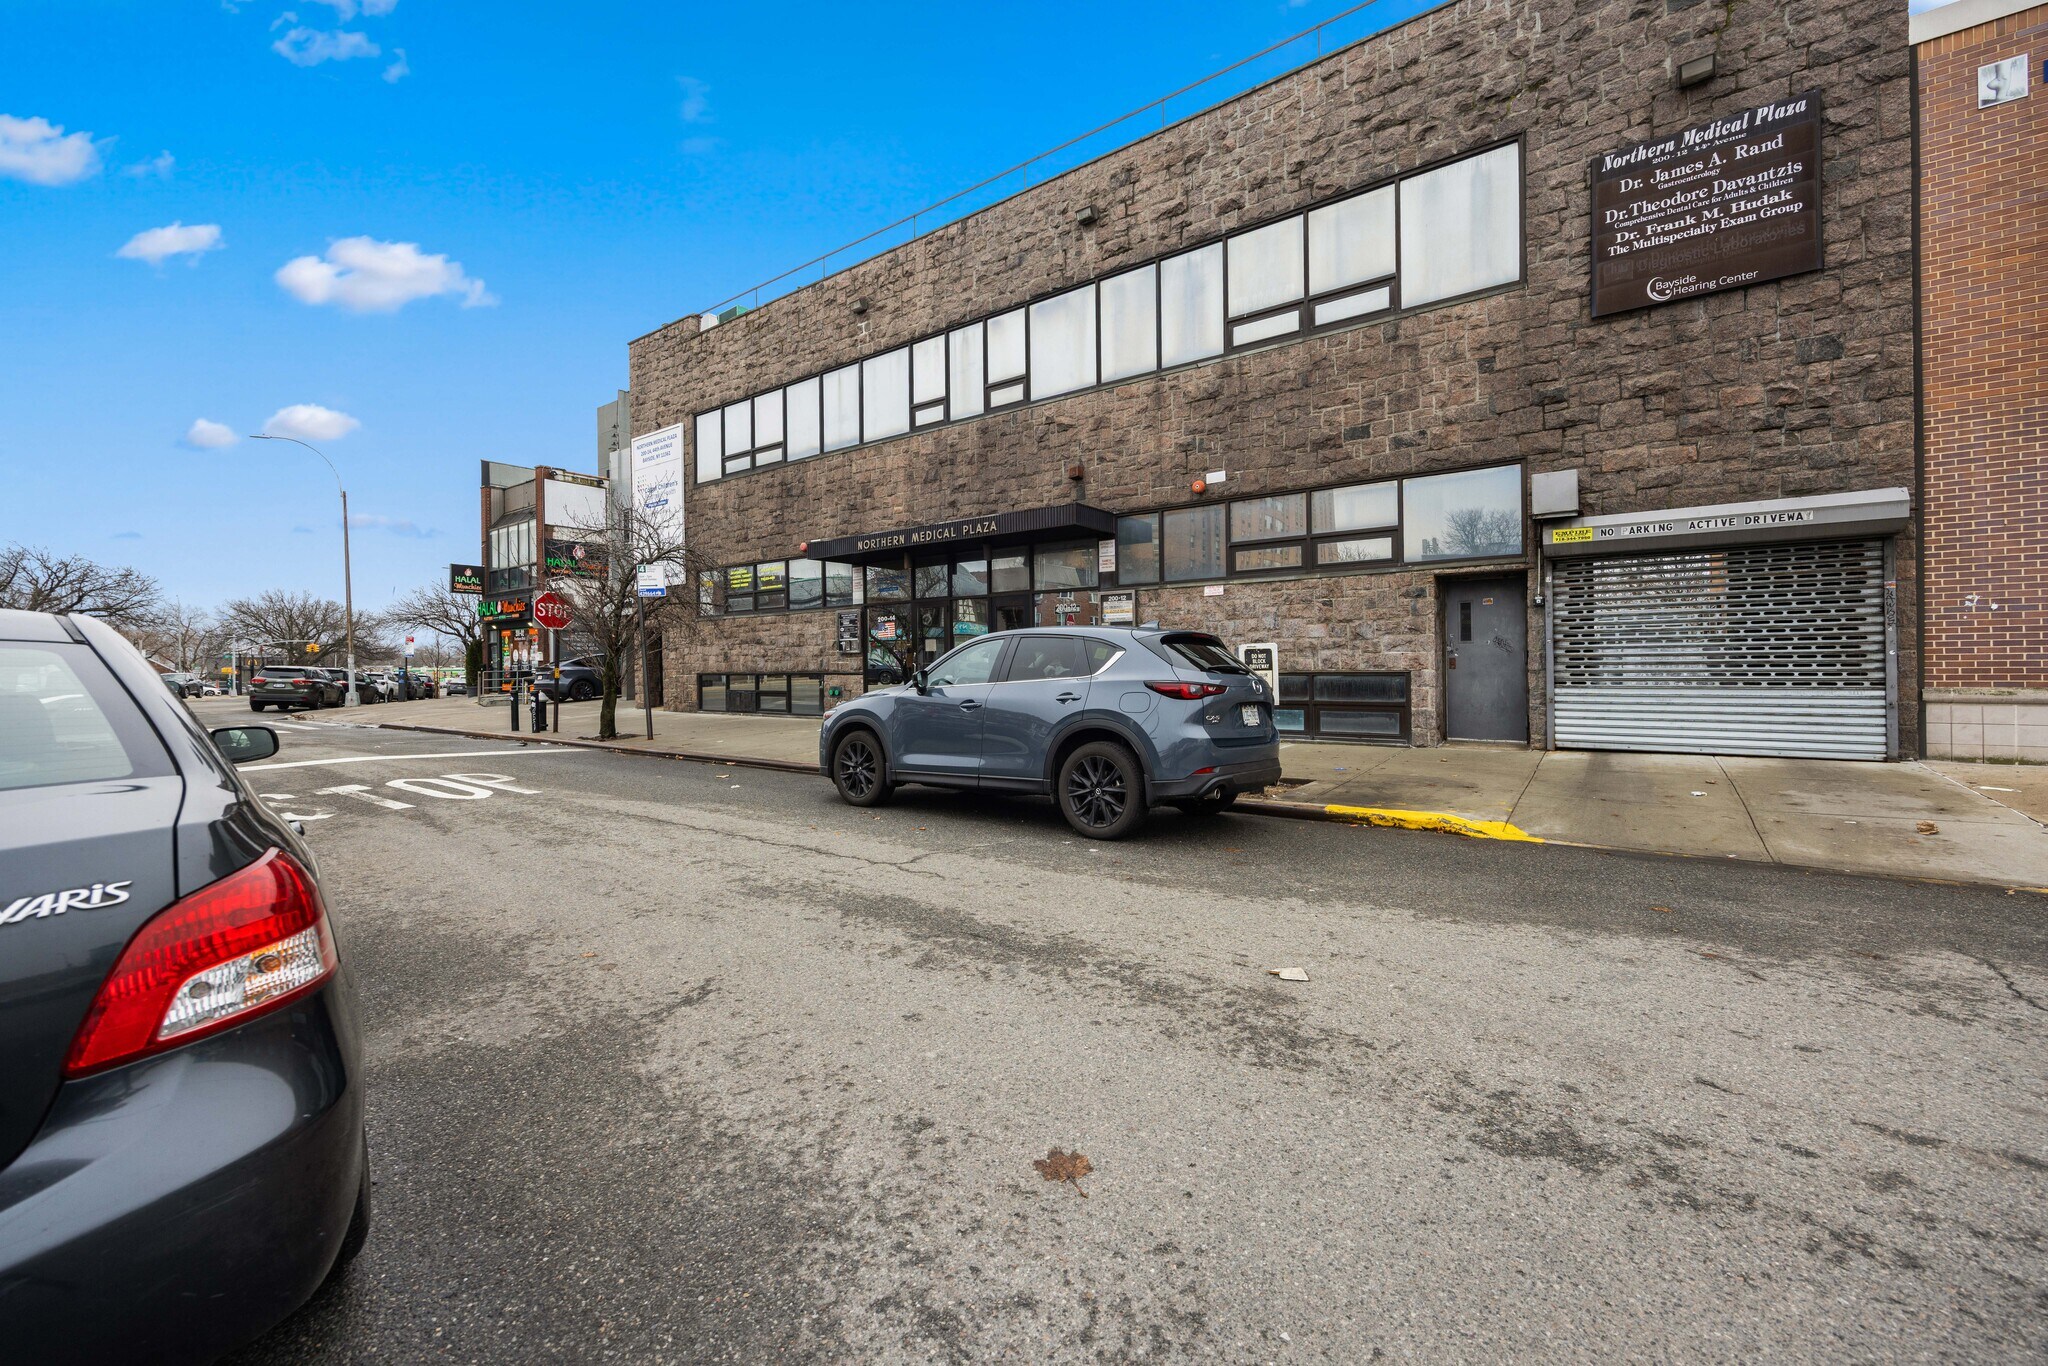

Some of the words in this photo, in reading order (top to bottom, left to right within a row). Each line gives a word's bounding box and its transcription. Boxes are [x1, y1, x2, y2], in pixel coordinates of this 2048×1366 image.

[1602, 140, 1675, 172] Northern
[1681, 112, 1749, 148] Medical
[1754, 100, 1807, 126] Plaza
[1712, 132, 1747, 146] Avenue
[1620, 178, 1643, 193] Dr.
[1650, 160, 1704, 184] James
[1708, 151, 1727, 167] A.
[1735, 133, 1783, 160] Rand
[1605, 209, 1628, 224] Dr.
[1629, 188, 1708, 217] Theodore
[1712, 161, 1802, 195] Davantzis
[1657, 168, 1721, 190] Gastroenterology
[1614, 212, 1666, 229] Comprehensive
[1667, 203, 1691, 215] Dental
[1692, 199, 1710, 209] Care
[1711, 195, 1722, 204] for
[1723, 189, 1748, 201] Adults
[1749, 186, 1757, 194] &
[1758, 177, 1793, 191] Children
[1615, 231, 1640, 244] Dr.
[1645, 214, 1697, 236] Frank
[1701, 206, 1724, 222] M.
[1730, 189, 1793, 214] Hudak
[1607, 244, 1630, 257] The
[1632, 223, 1717, 251] Multispecialty
[1720, 213, 1757, 229] Exam
[1760, 202, 1803, 218] Group
[1655, 275, 1697, 291] Bayside
[1673, 281, 1717, 296] Hearing
[1719, 270, 1759, 285] Center
[857, 534, 905, 550] NORTHERN
[911, 527, 956, 543] MEDICAL
[963, 521, 997, 535] PLAZA
[1600, 528, 1614, 537] NO
[1689, 517, 1736, 529] ACTIVE
[455, 575, 480, 584] HALAL
[477, 600, 499, 617] HALAL
[258, 772, 543, 821] STOP
